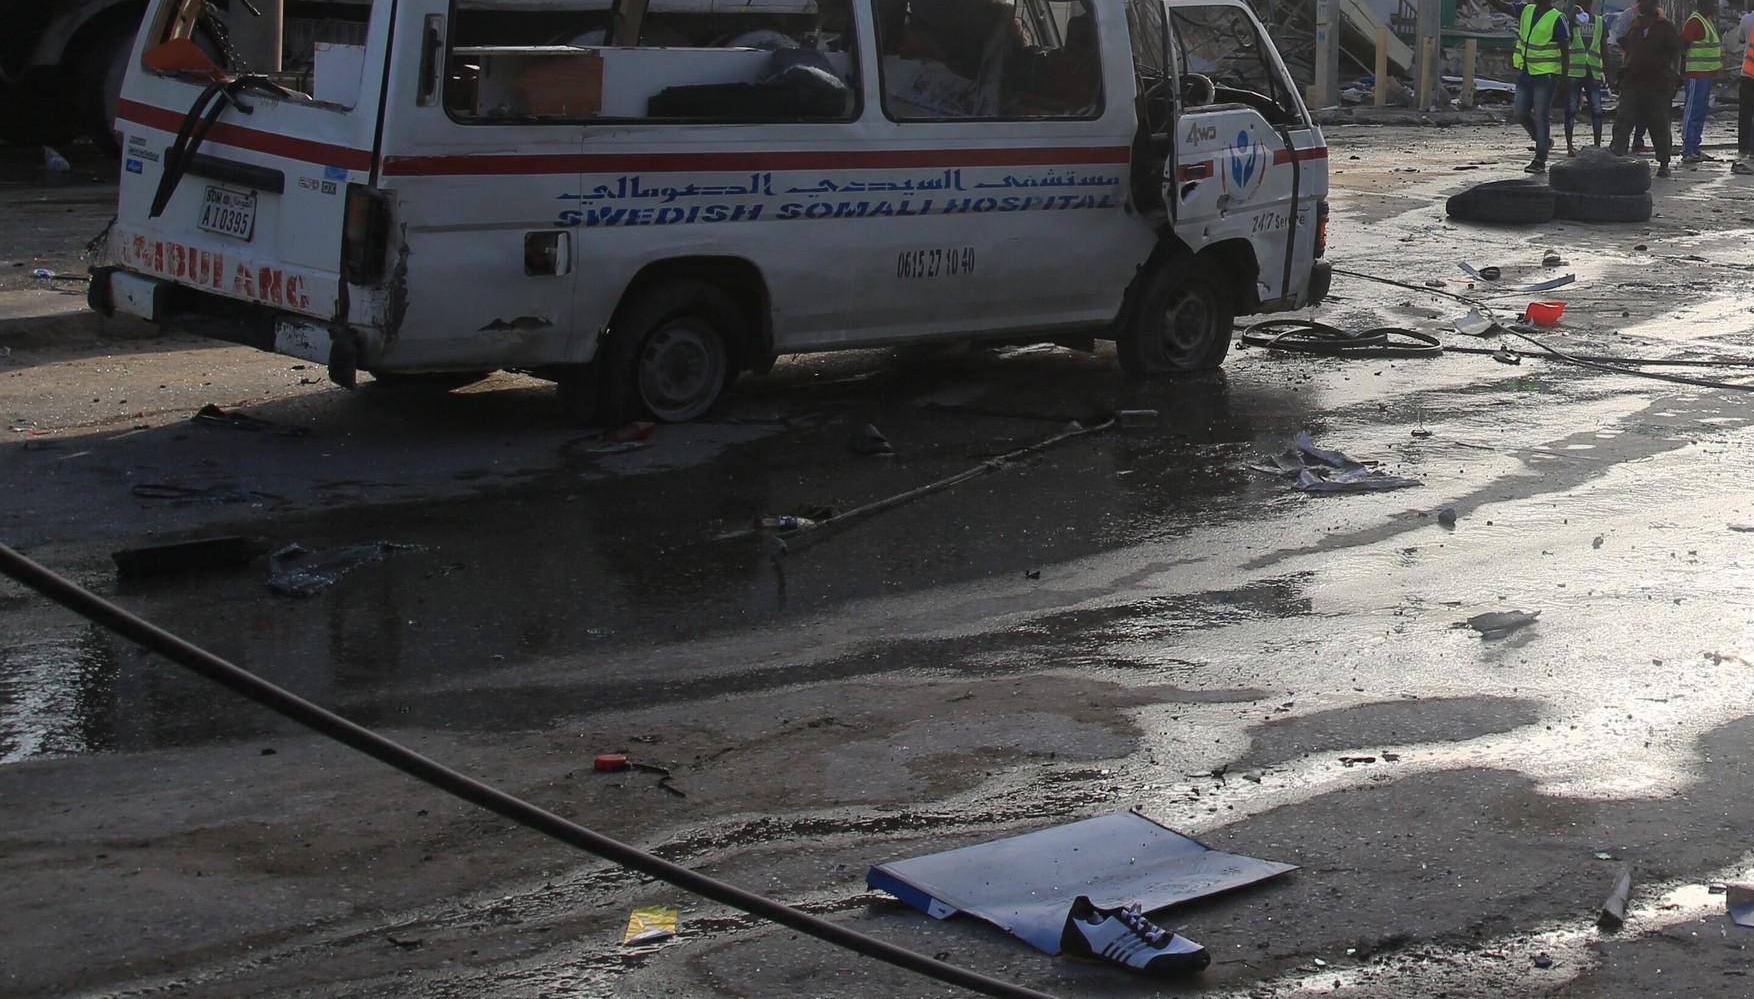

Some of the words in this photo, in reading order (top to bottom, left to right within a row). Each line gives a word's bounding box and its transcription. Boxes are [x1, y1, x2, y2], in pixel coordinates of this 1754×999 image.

[1185, 122, 1217, 147] 4WD
[552, 203, 764, 228] SWEDISH
[775, 198, 933, 220] SOMALI
[942, 194, 1117, 215] HOSPITAL
[896, 249, 924, 279] 0615
[928, 249, 942, 278] 27
